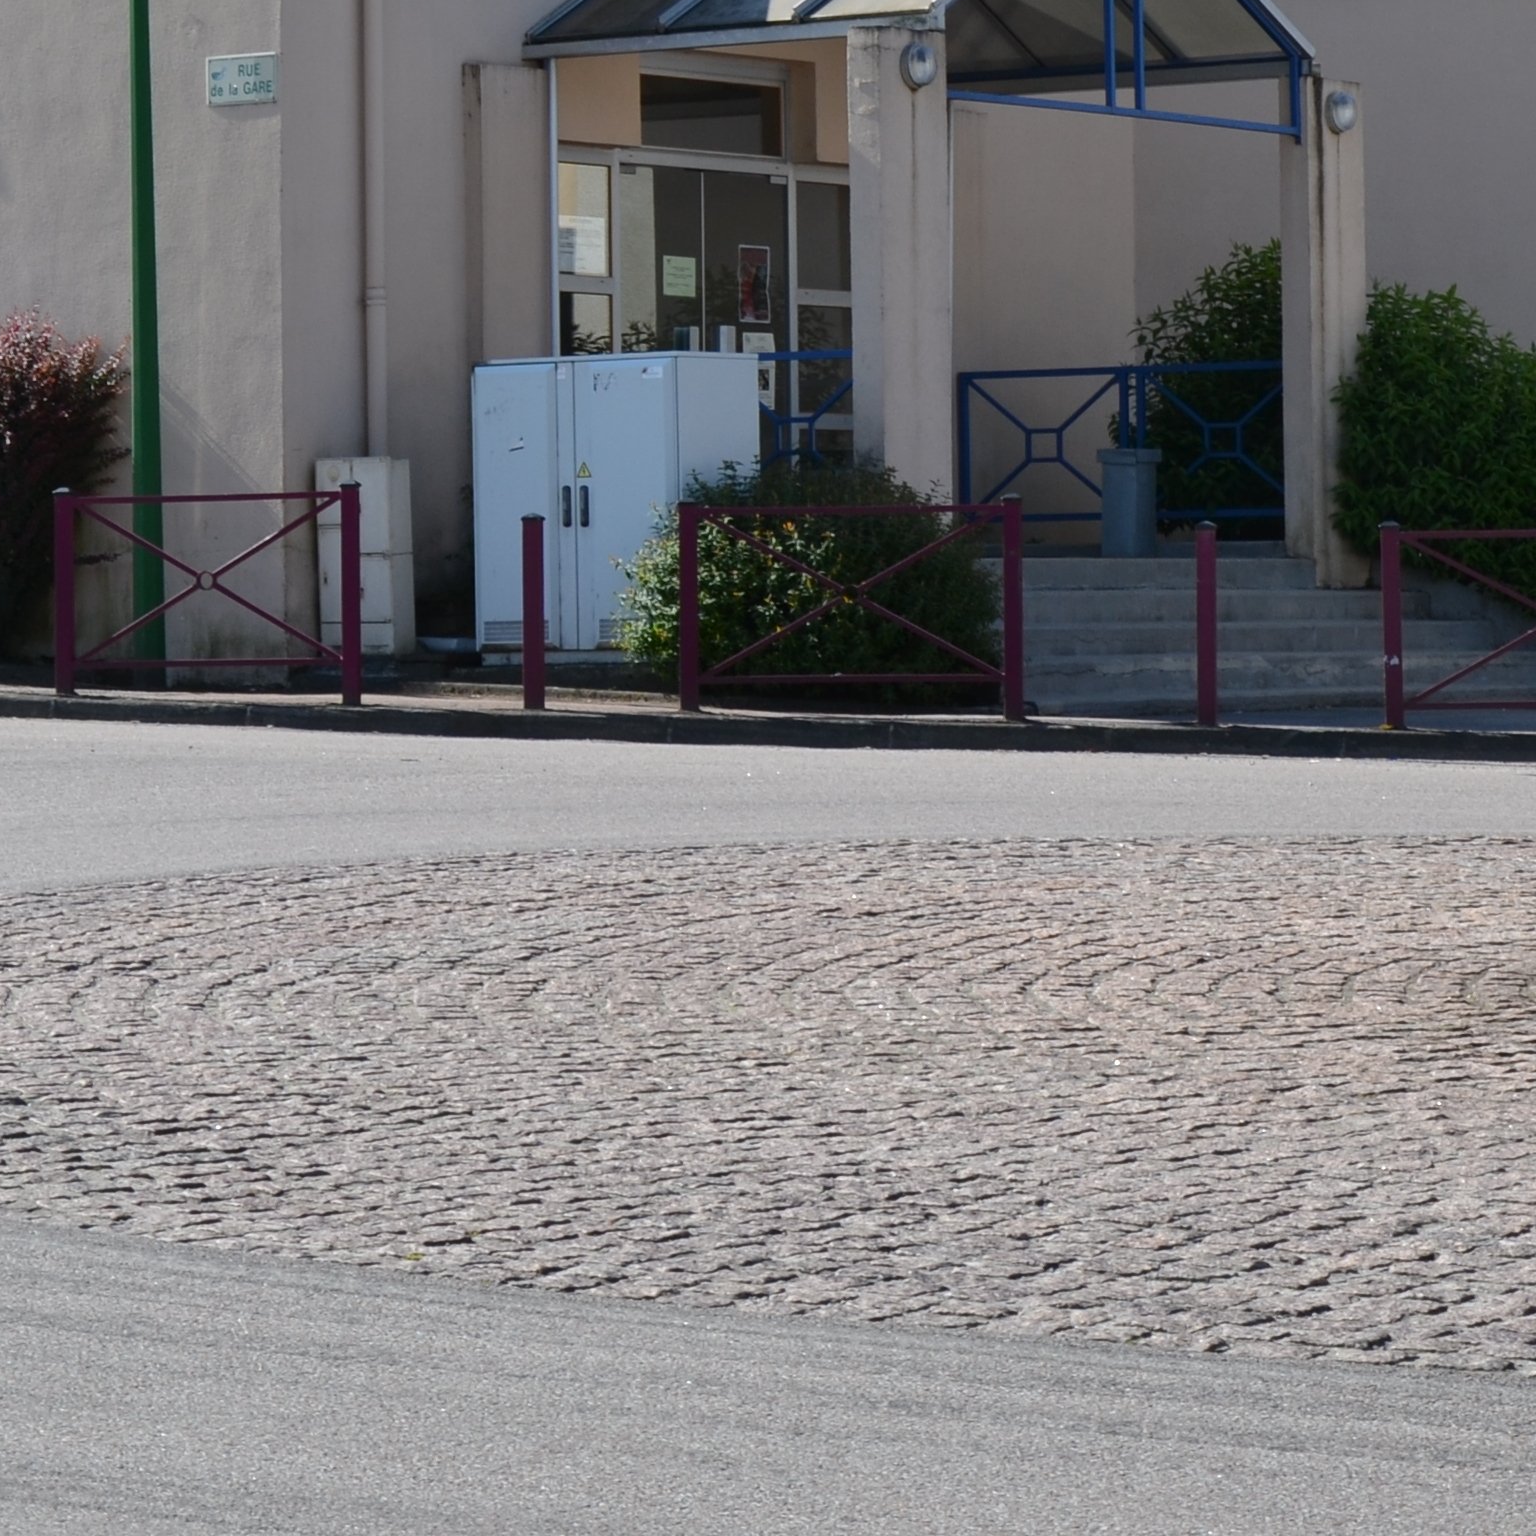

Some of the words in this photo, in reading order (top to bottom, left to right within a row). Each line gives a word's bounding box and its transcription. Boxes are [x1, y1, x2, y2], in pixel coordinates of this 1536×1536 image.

[238, 63, 261, 77] RUE
[210, 84, 224, 97] de
[228, 82, 239, 96] la
[243, 80, 273, 95] GARE
